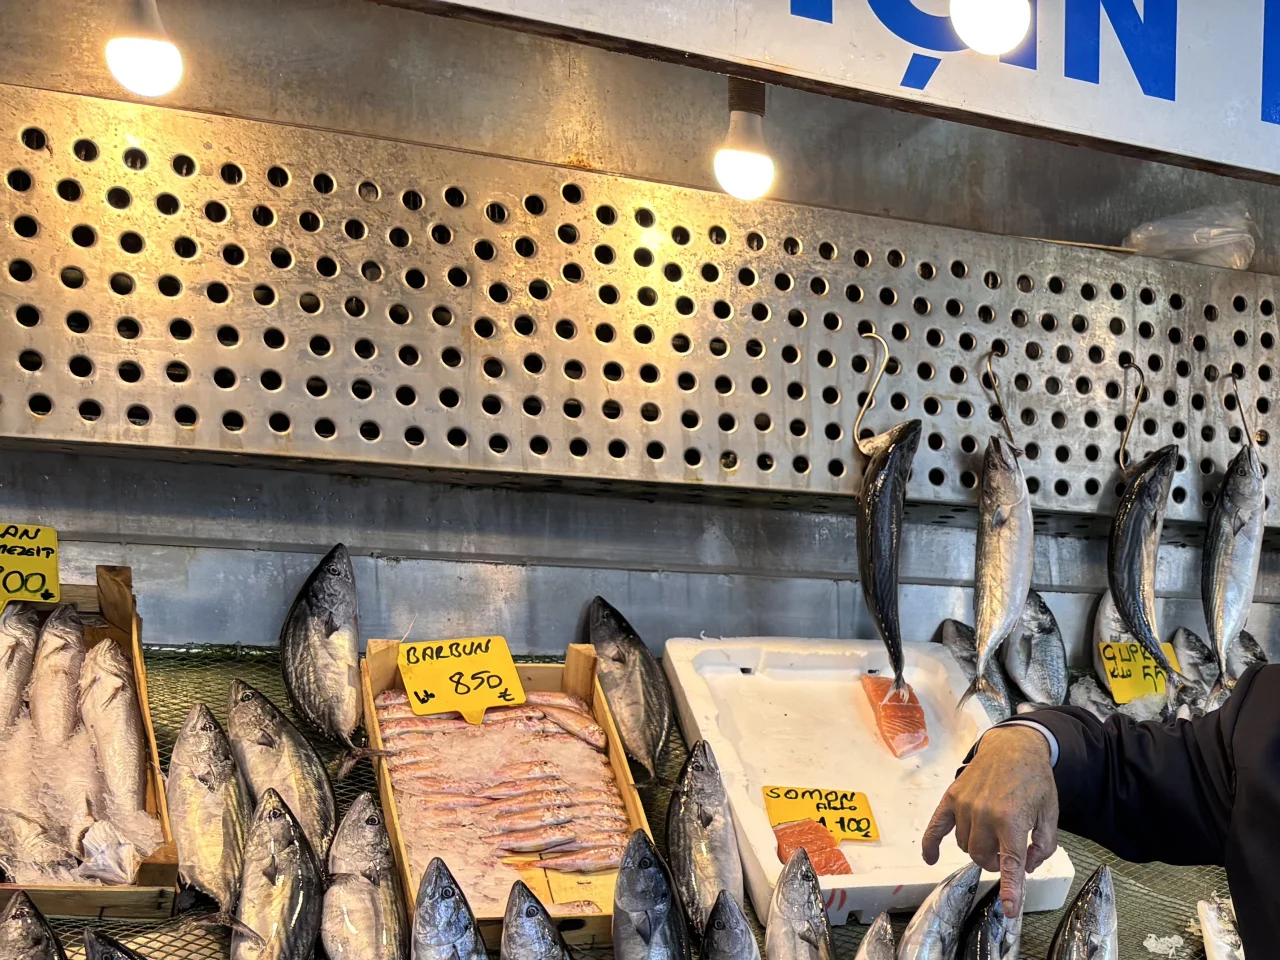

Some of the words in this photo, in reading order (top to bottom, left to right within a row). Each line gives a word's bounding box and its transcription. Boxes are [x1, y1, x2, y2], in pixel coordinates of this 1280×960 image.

[406, 639, 492, 665] BARBUN
[449, 670, 503, 695] 850
[765, 787, 856, 802] SOMON
